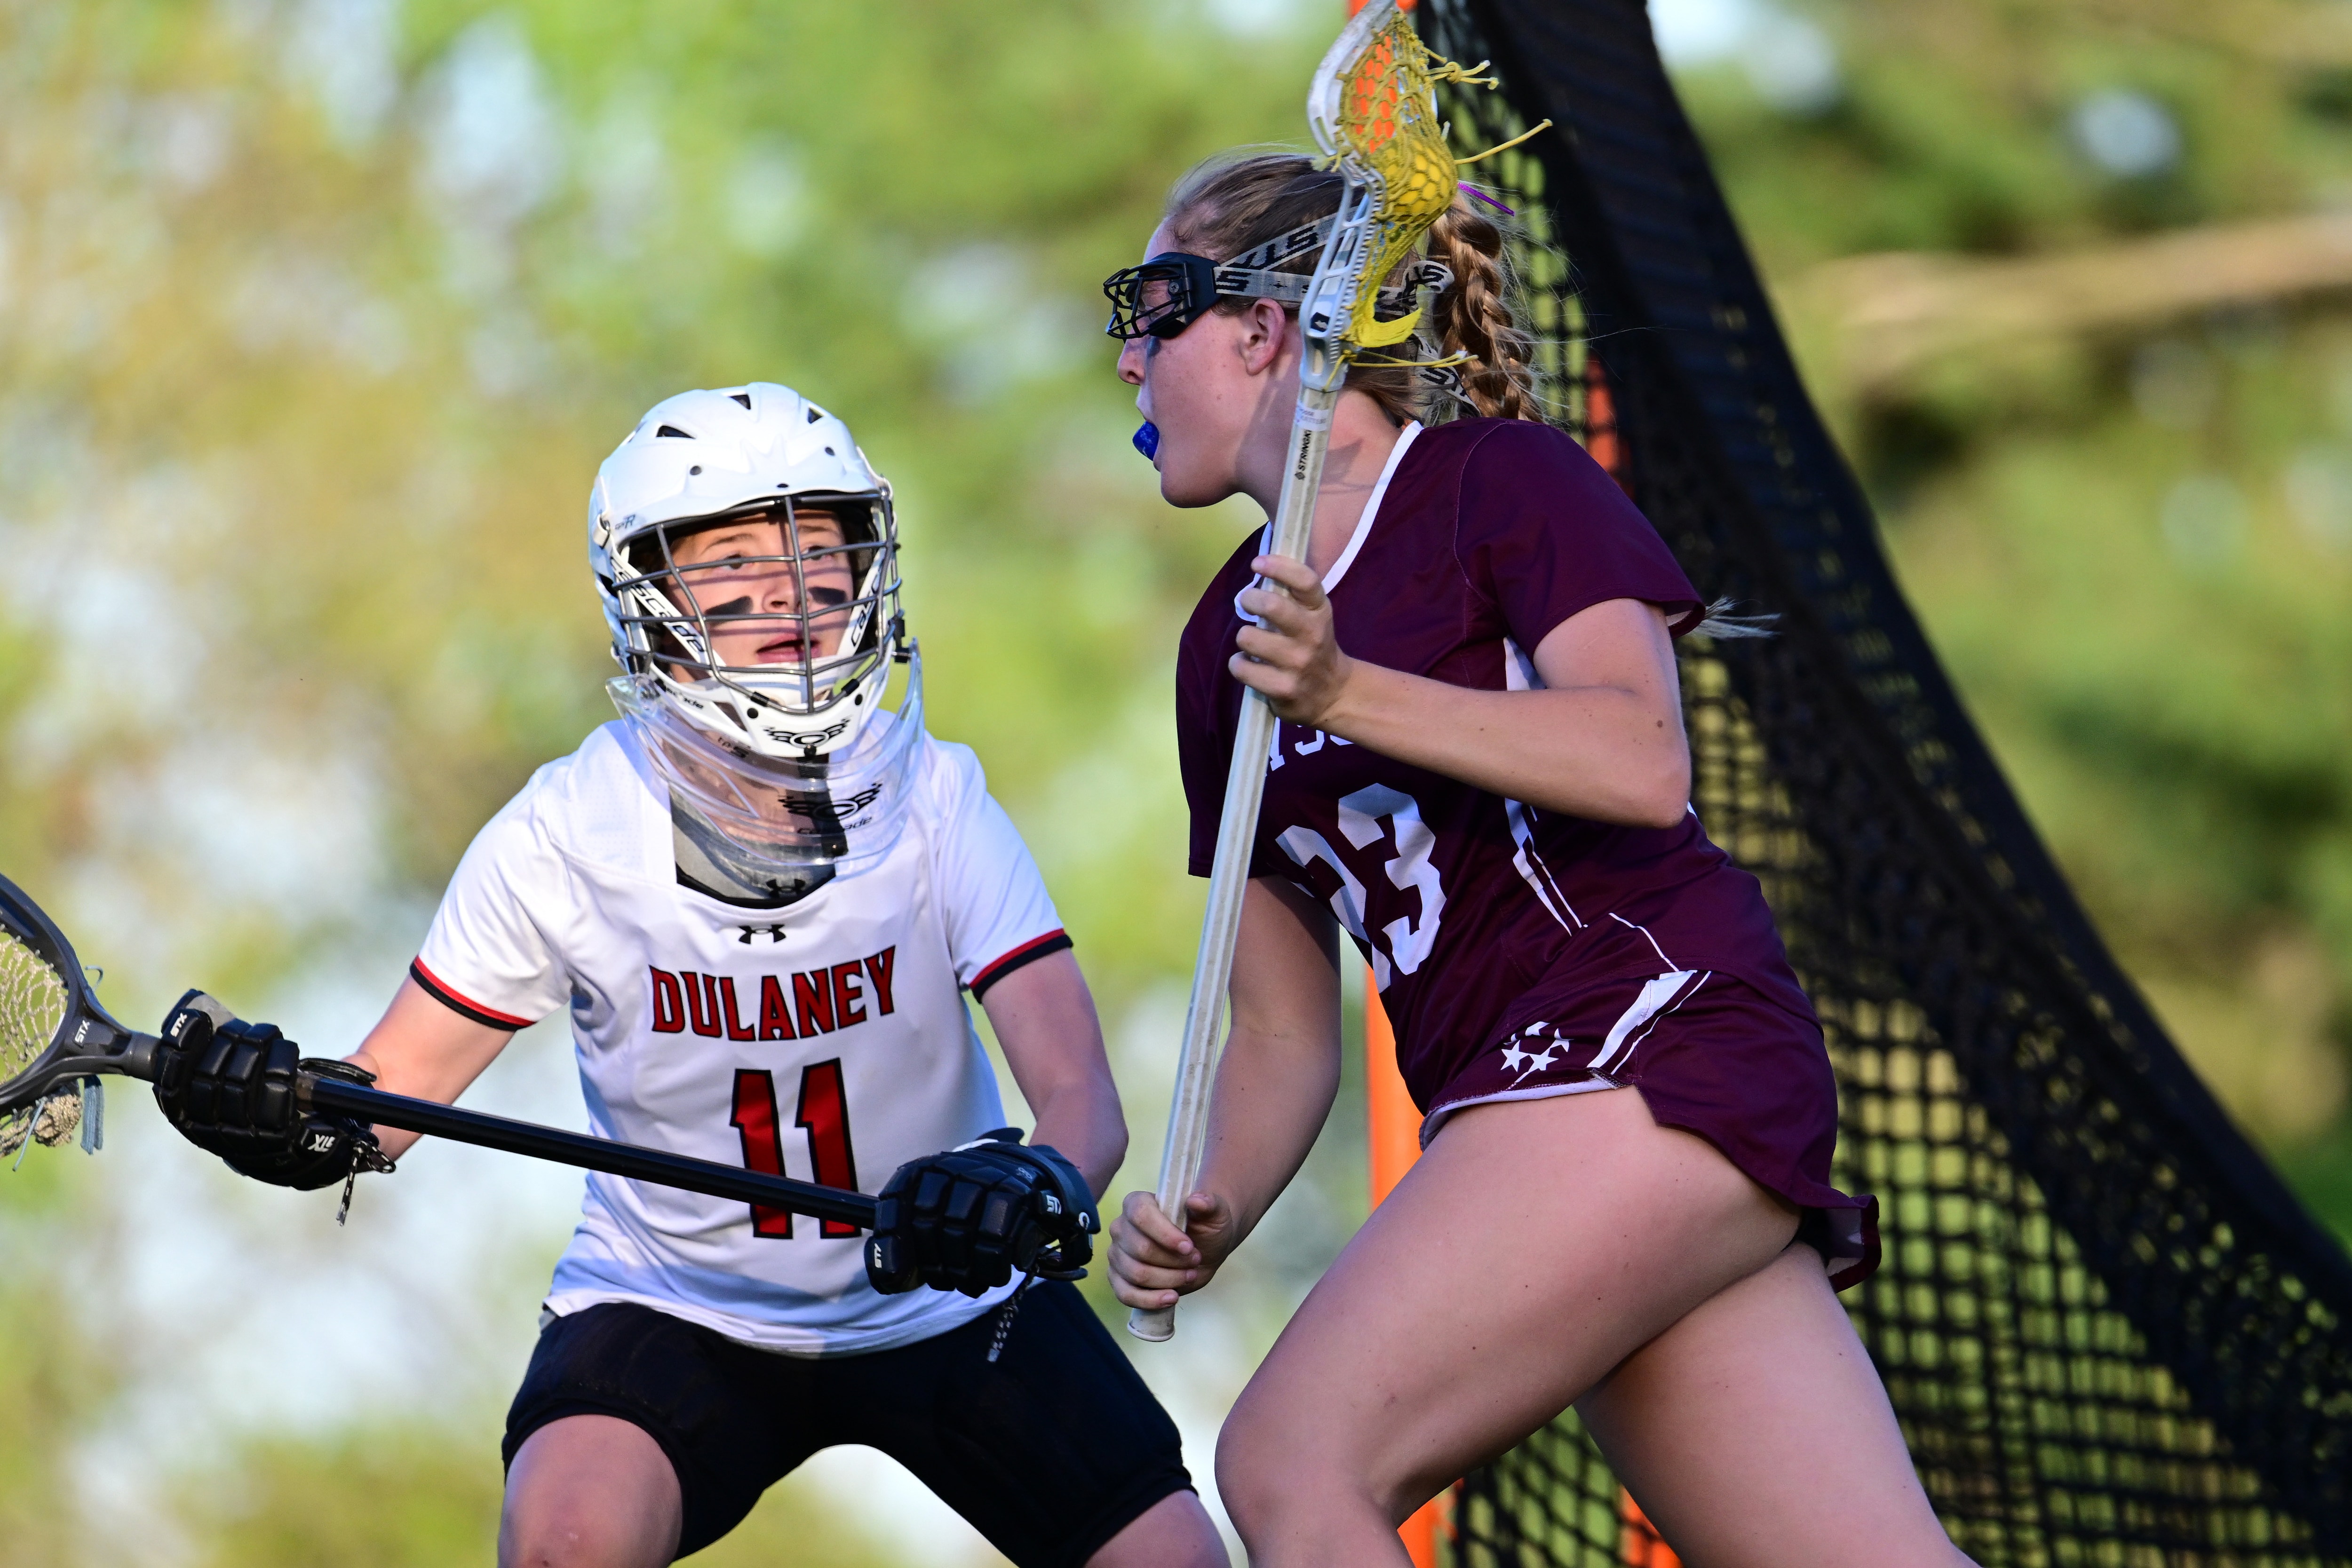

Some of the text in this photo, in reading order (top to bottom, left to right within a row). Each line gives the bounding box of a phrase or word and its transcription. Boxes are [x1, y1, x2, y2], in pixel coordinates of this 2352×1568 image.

[648, 944, 896, 1042] DULANEY
[74, 1019, 90, 1044] STX
[170, 1012, 187, 1037] STX
[729, 1057, 862, 1239] 11
